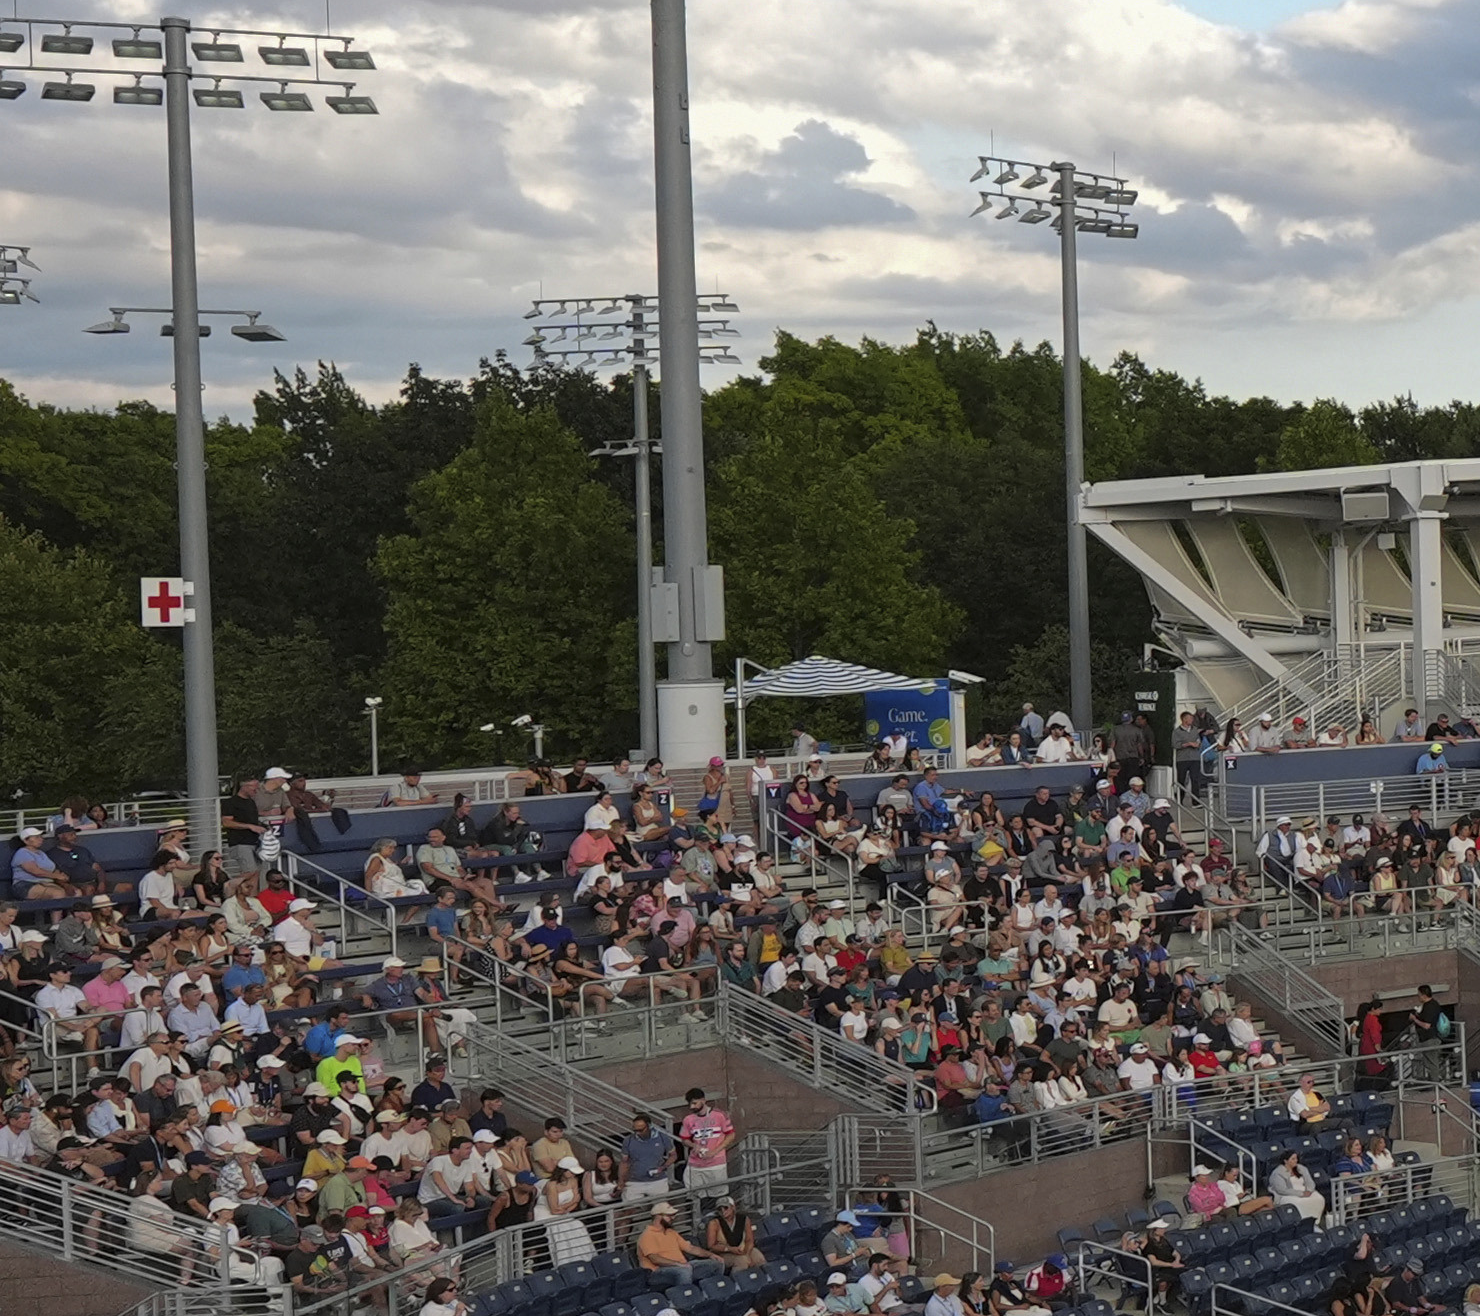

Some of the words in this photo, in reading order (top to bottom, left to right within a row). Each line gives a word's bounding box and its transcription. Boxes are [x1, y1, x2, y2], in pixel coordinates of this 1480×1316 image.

[888, 707, 928, 723] Game.
[769, 788, 778, 797] Y
[660, 794, 667, 804] Z
[272, 825, 281, 836] Z
